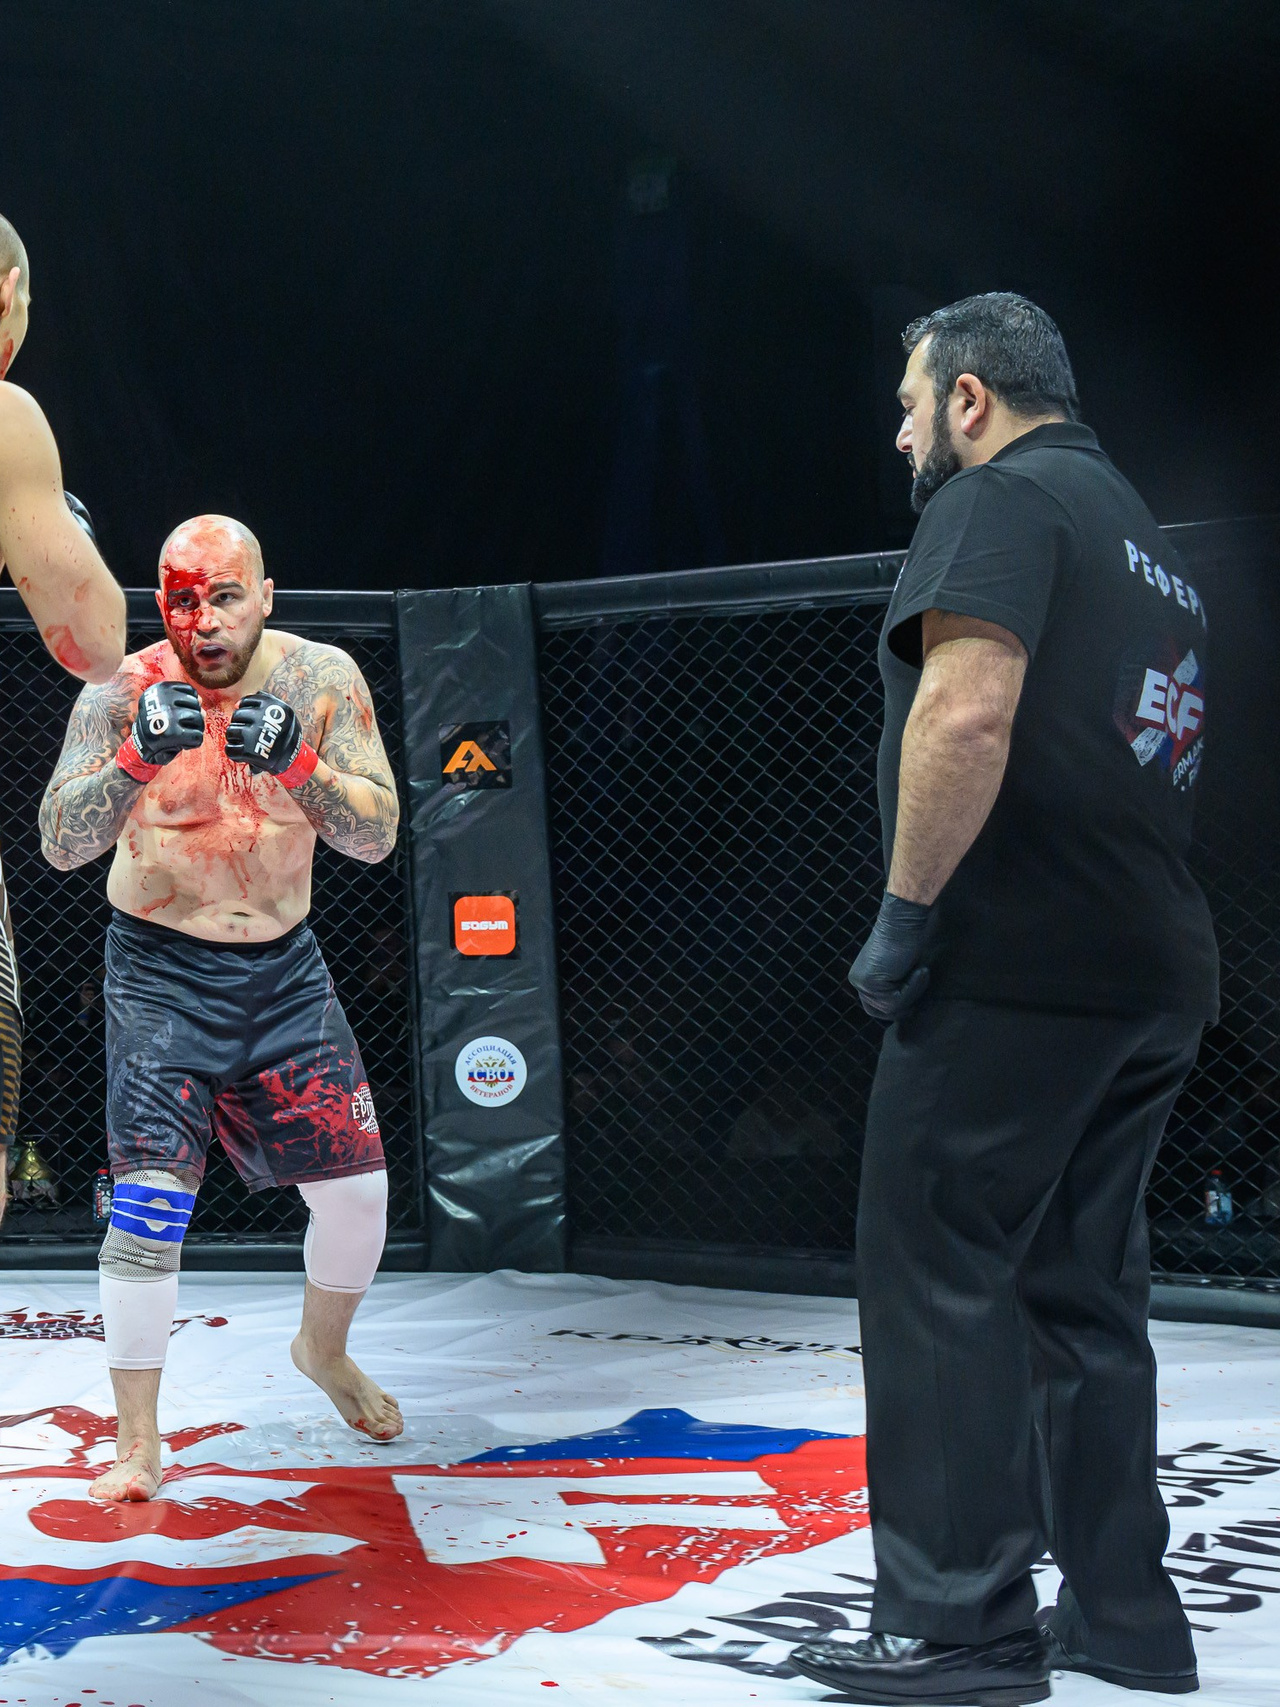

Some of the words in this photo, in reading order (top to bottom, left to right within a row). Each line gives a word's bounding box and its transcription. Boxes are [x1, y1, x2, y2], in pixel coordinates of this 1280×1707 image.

[1136, 668, 1204, 740] ECF
[465, 1045, 517, 1066] АССОЦИАЦИЯ
[473, 1067, 510, 1081] СВО
[470, 1084, 514, 1098] ВЕТЕРАНОВ
